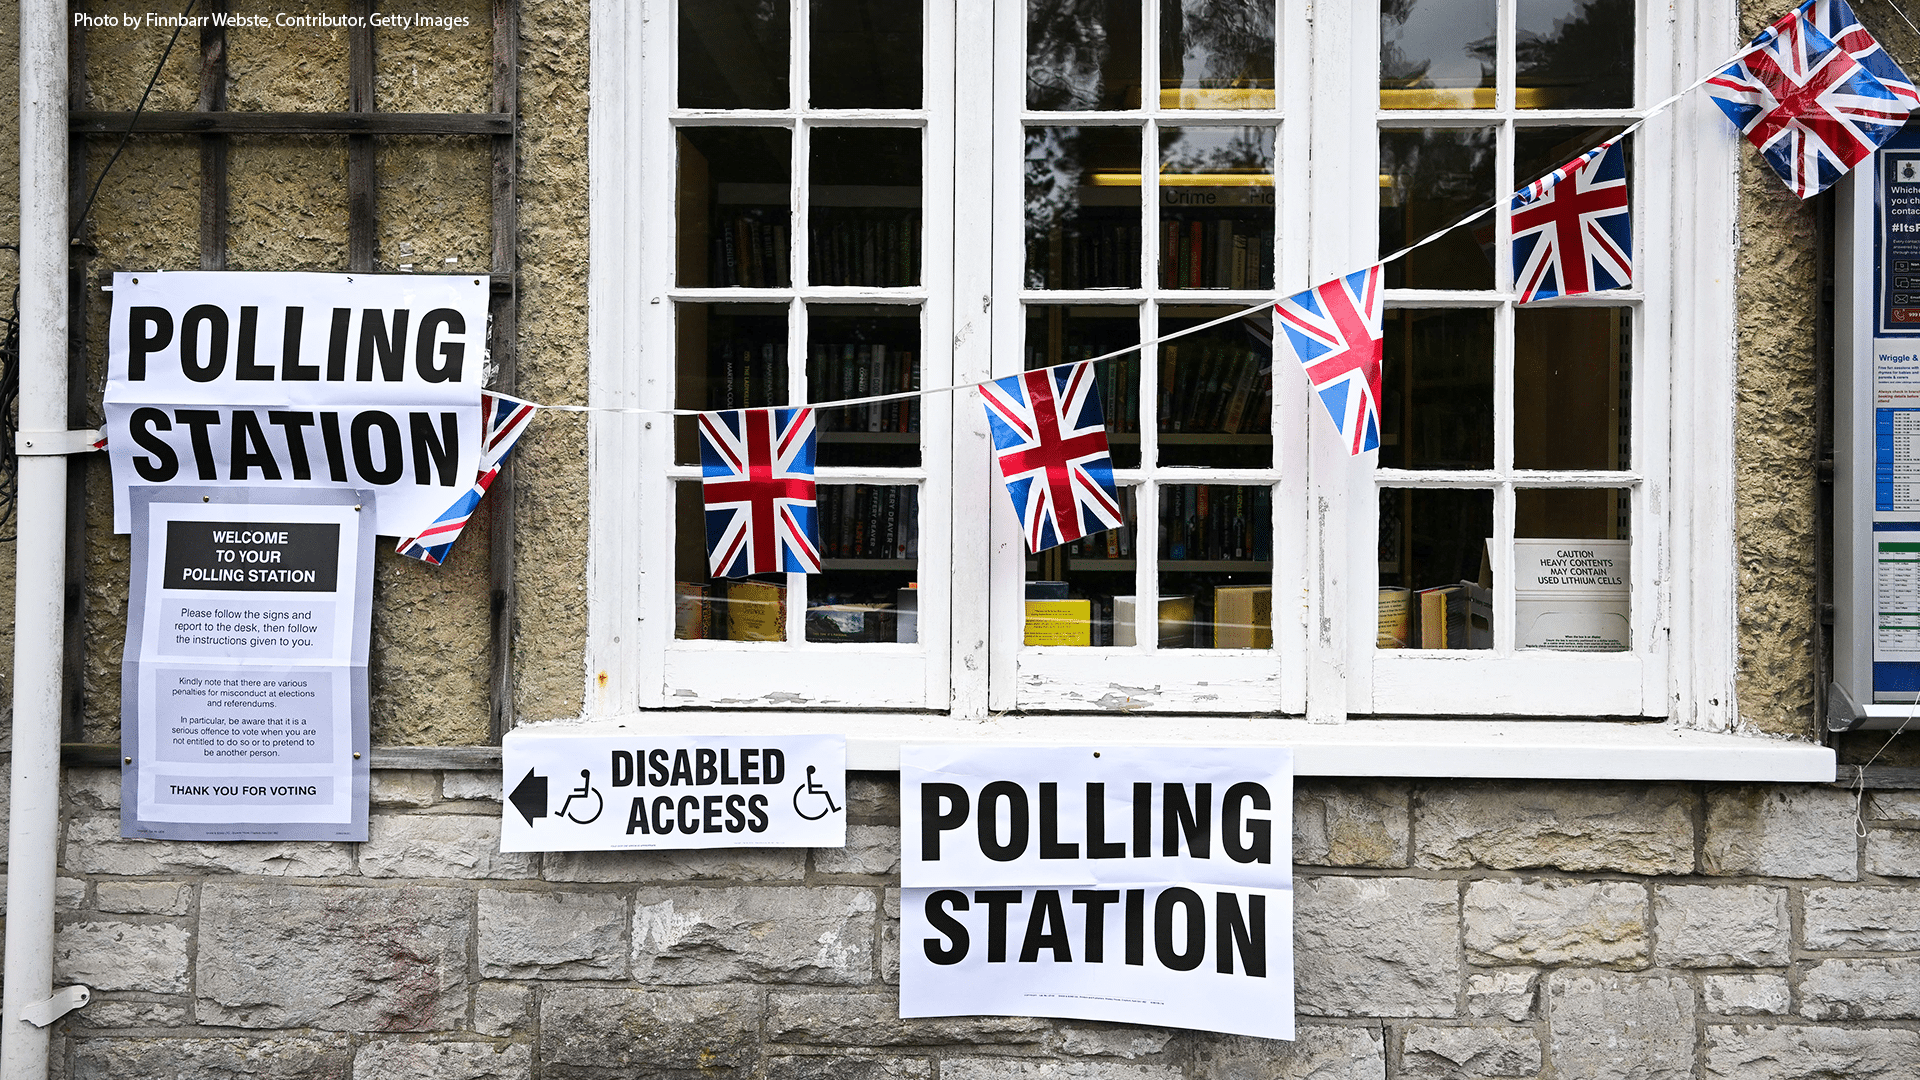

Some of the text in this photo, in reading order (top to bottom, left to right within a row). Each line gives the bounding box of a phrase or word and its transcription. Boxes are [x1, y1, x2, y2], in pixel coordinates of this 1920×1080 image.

[1165, 190, 1216, 204] Crime
[1891, 198, 1907, 206] you
[128, 304, 466, 383] POLLING
[1879, 354, 1910, 363] Wriggle
[128, 406, 458, 486] STATION
[887, 511, 895, 543] DEAVER
[213, 530, 289, 544] WELCOME
[216, 550, 281, 563] TO YOUR
[1557, 550, 1594, 558] CAUTION
[1570, 559, 1613, 567] CONTENTS
[183, 568, 315, 582] POLLING STATION
[1570, 568, 1607, 576] CONTAIN
[1561, 577, 1596, 585] LITHIUM
[1597, 577, 1622, 585] CELLS
[181, 608, 311, 622] Please follow the signs and
[174, 622, 317, 634] report to the desk, then follow
[176, 635, 314, 648] the instructions given to you.
[179, 677, 202, 687] Kindly
[224, 678, 239, 687] that
[241, 679, 261, 687] there
[278, 680, 307, 688] various
[172, 688, 206, 697] penalties
[208, 688, 218, 696] for
[220, 689, 267, 697] misconduct
[278, 689, 315, 698] elections
[207, 699, 277, 708] and referendums.
[181, 716, 187, 724] In
[189, 716, 227, 726] particular,
[228, 717, 240, 725] be
[172, 727, 199, 735] serious
[201, 727, 230, 735] offence
[232, 728, 240, 736] to
[242, 728, 259, 736] vote
[261, 728, 283, 736] when
[285, 730, 301, 738] you
[187, 738, 215, 746] entitled
[226, 738, 238, 746] do
[273, 739, 304, 748] pretend
[216, 749, 247, 757] another
[249, 750, 280, 758] person.
[611, 748, 785, 787] DISABLED
[170, 785, 317, 796] THANK YOU FOR VOTING
[626, 794, 769, 835] ACCESS
[921, 780, 1272, 865] POLLING
[923, 887, 1267, 978] STATION
